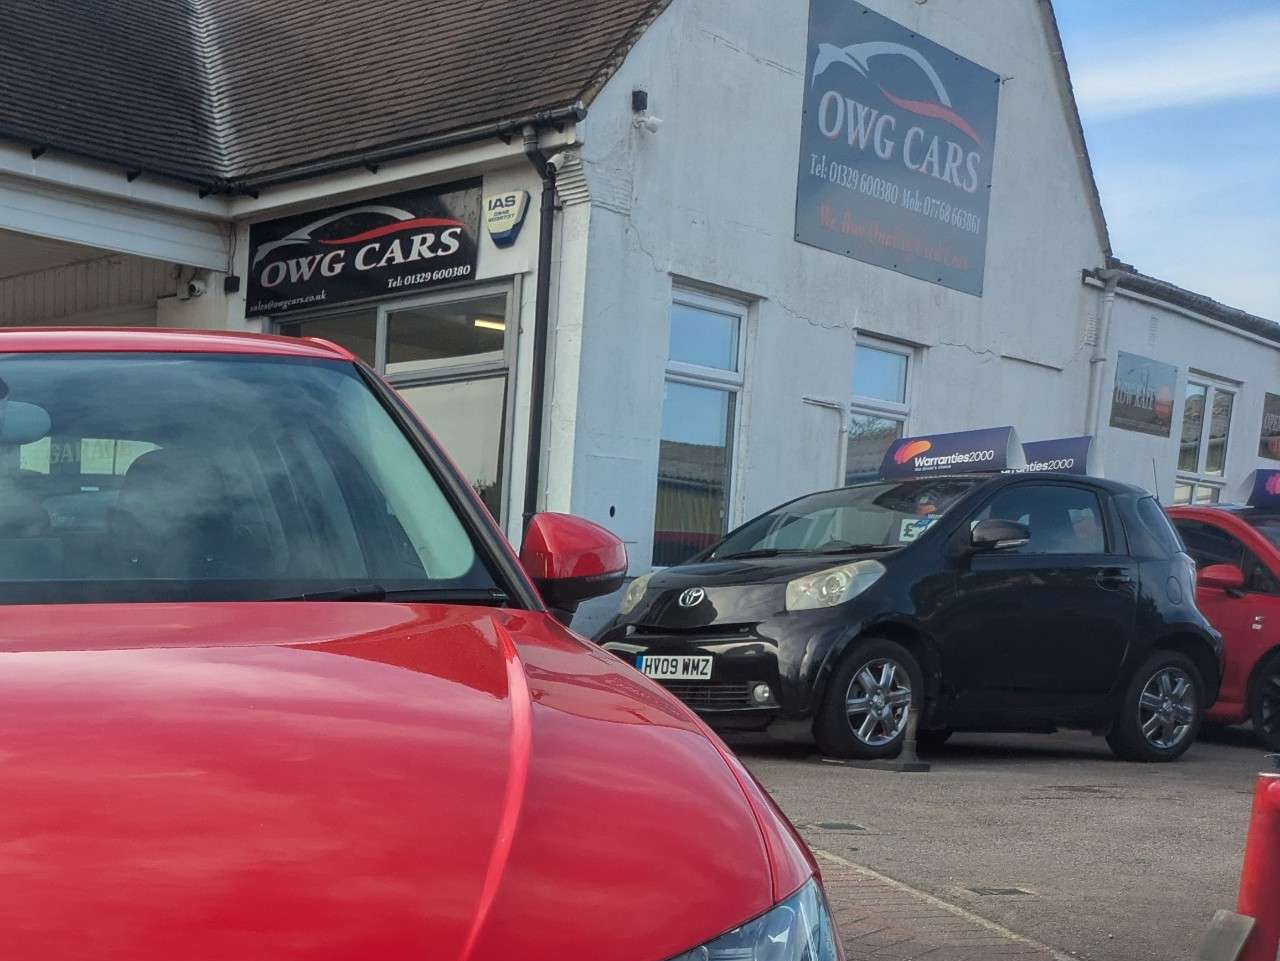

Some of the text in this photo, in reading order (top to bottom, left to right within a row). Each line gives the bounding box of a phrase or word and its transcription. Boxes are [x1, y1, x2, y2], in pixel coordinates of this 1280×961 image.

[818, 91, 981, 193] OWG CARS
[810, 153, 828, 180] Tel:
[829, 161, 859, 191] 01329
[860, 173, 898, 205] 600380
[488, 195, 516, 211] IAS
[261, 227, 463, 288] OWG CARS
[387, 264, 471, 289] Tel: 01329 600380
[914, 450, 995, 468] Warranties2000
[644, 658, 709, 676] HV09 WMZ
